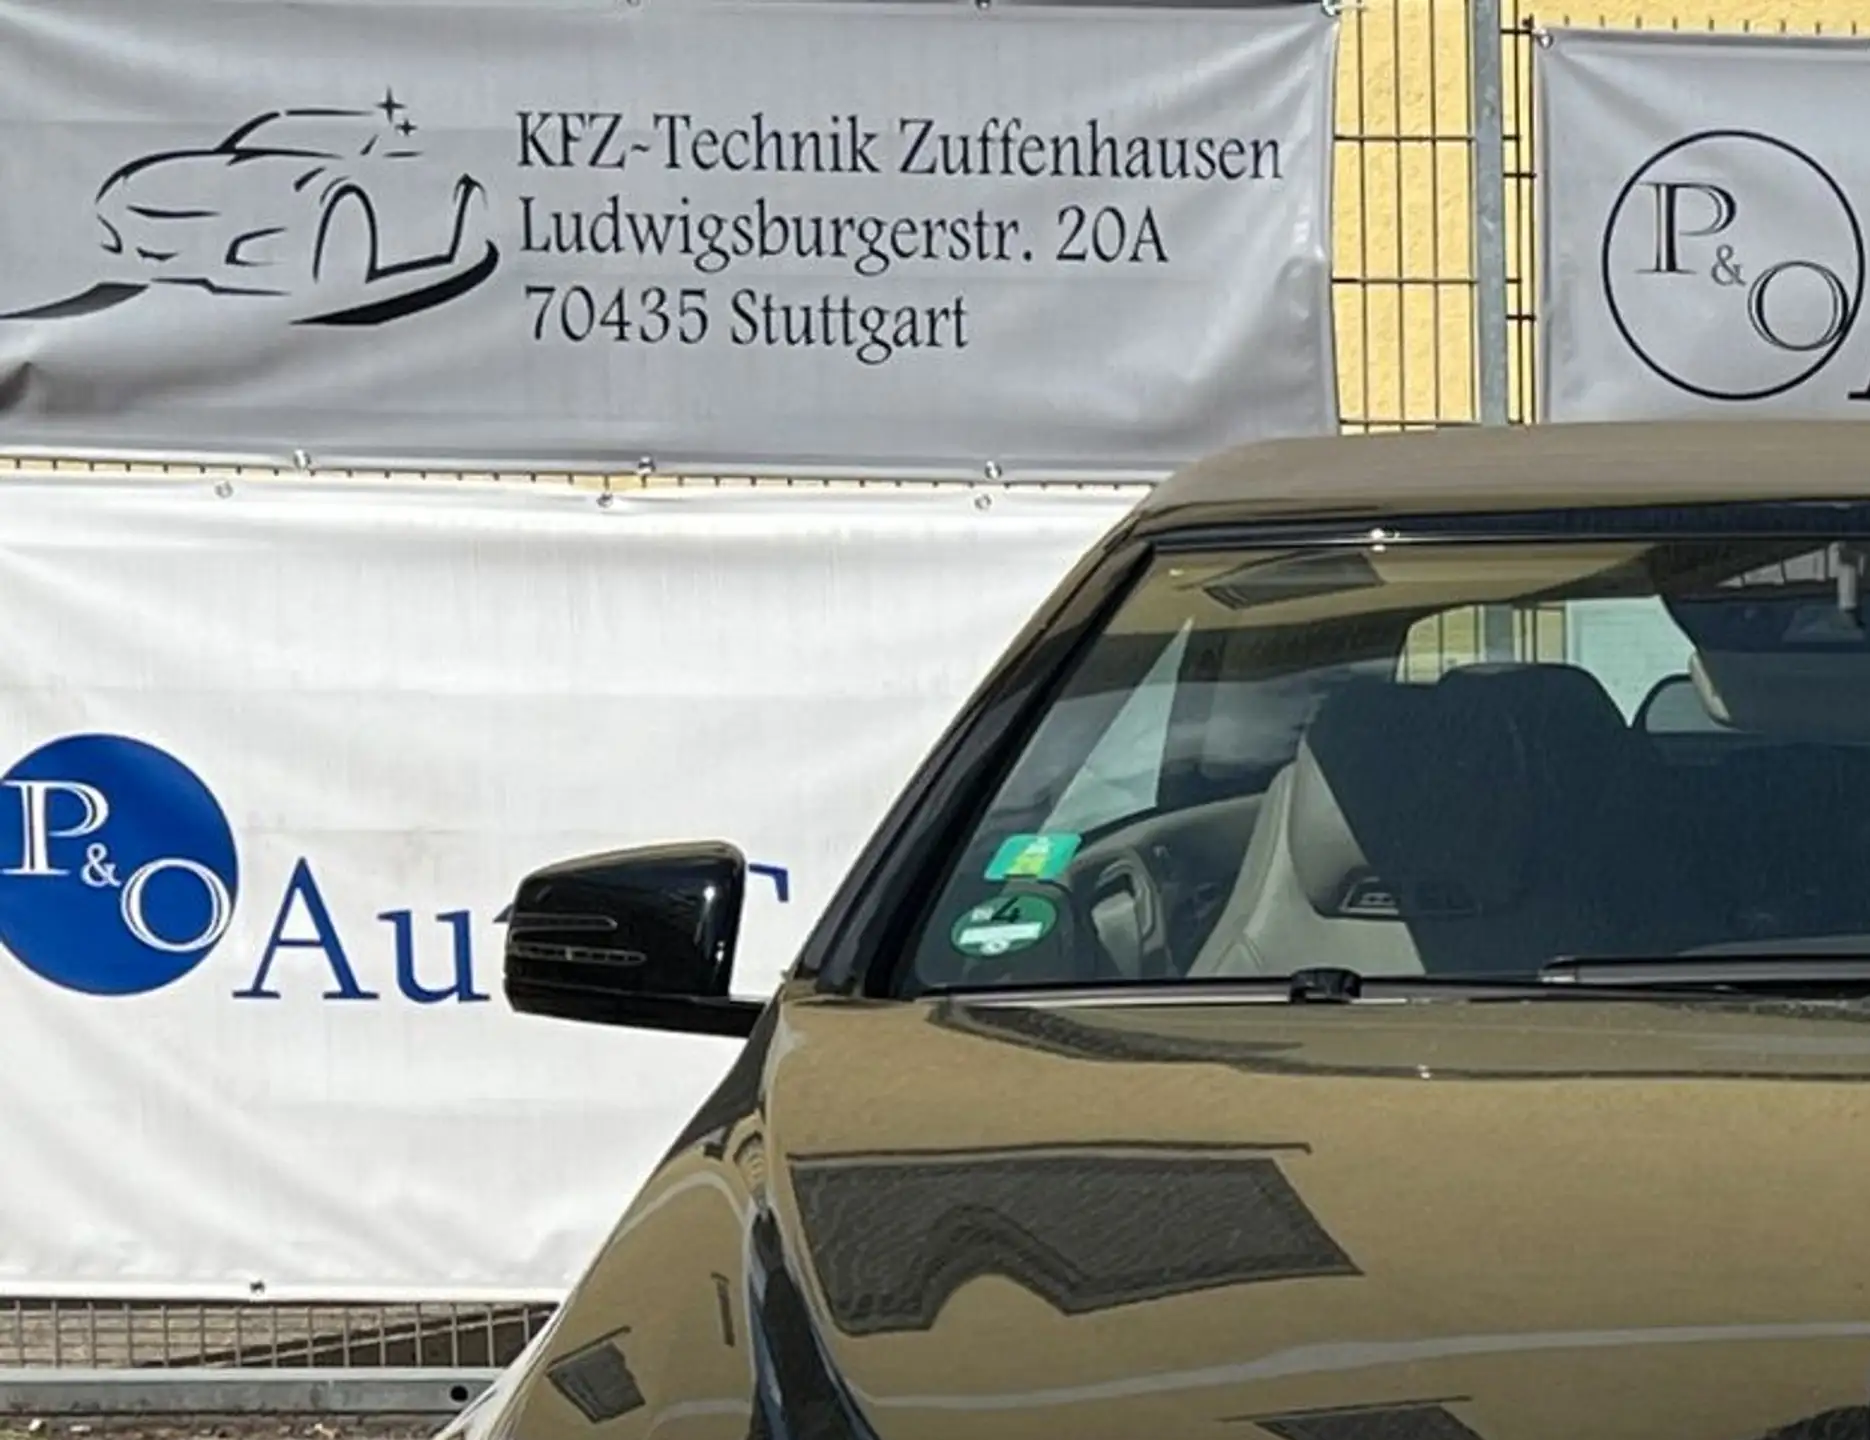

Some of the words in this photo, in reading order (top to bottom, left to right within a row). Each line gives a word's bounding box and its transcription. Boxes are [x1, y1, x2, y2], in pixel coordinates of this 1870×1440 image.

[898, 117, 1283, 180] Zuffenhausen
[517, 196, 1034, 276] Ludwigsburgerstr.
[1055, 205, 1170, 266] 20A
[1636, 180, 1851, 352] P&O
[524, 285, 710, 345] 70435
[730, 287, 970, 365] Stuttgart
[0, 778, 231, 953] P&O
[990, 897, 1021, 924] 4
